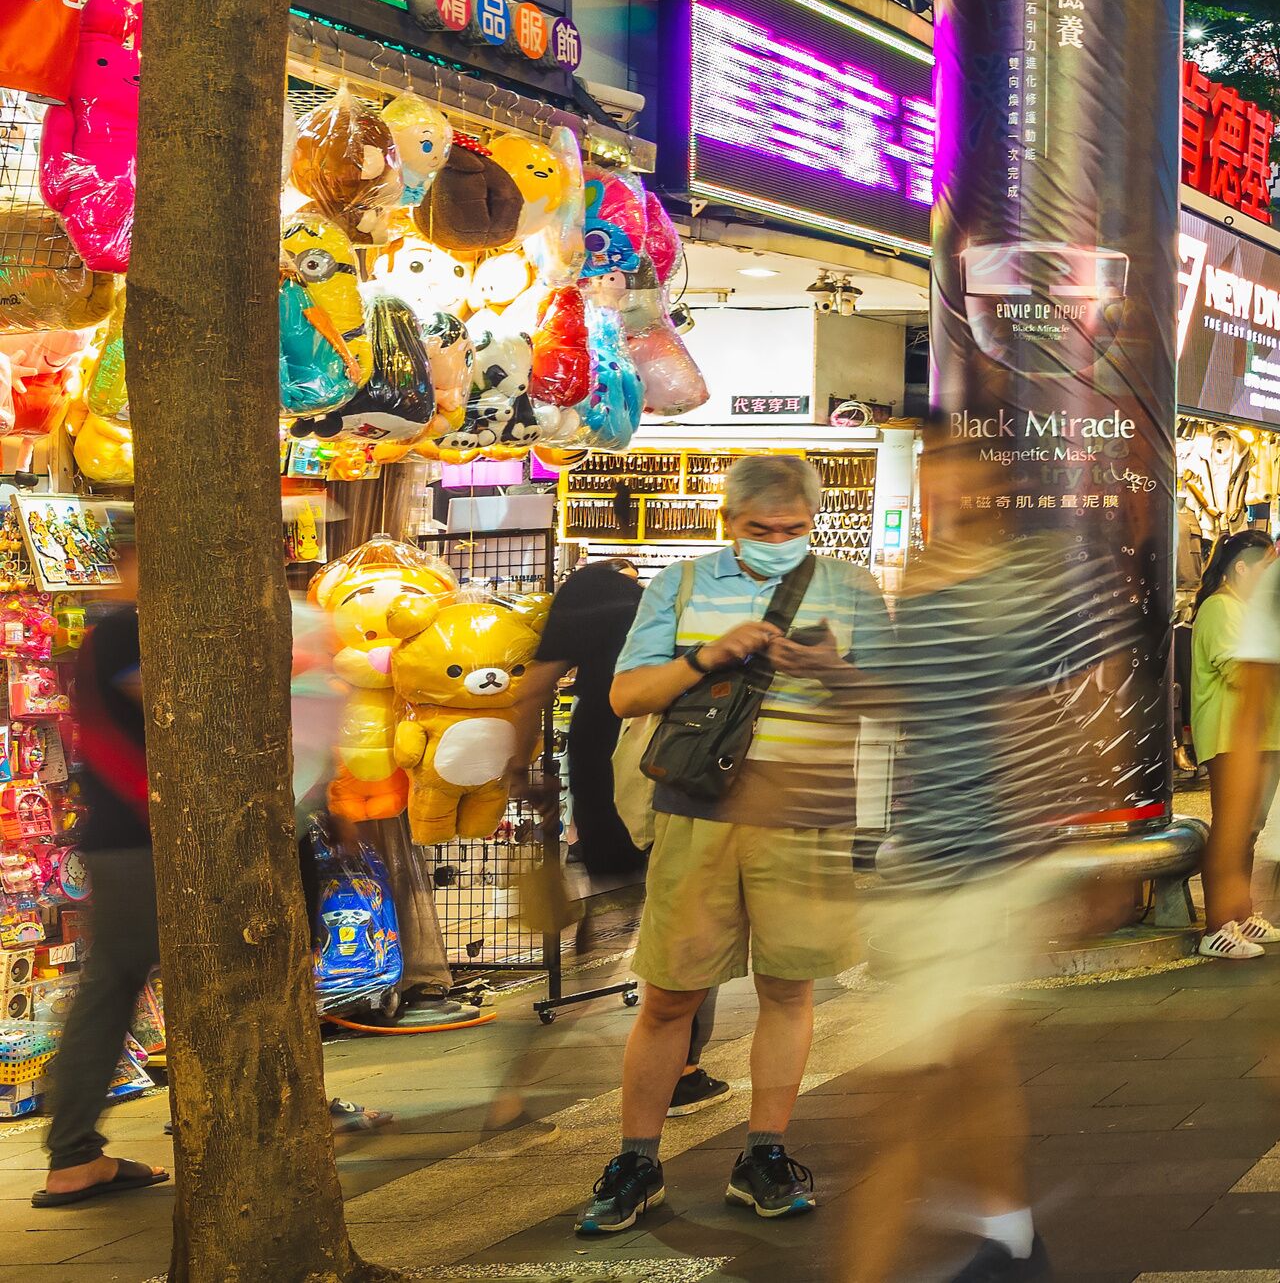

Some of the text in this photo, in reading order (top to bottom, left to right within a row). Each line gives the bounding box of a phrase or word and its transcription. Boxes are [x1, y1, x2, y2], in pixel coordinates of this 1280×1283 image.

[1204, 315, 1222, 332] THE
[734, 398, 799, 414] 代客穿耳
[949, 409, 1135, 439] Black Miracle
[979, 447, 1097, 466] Magnetic Mask
